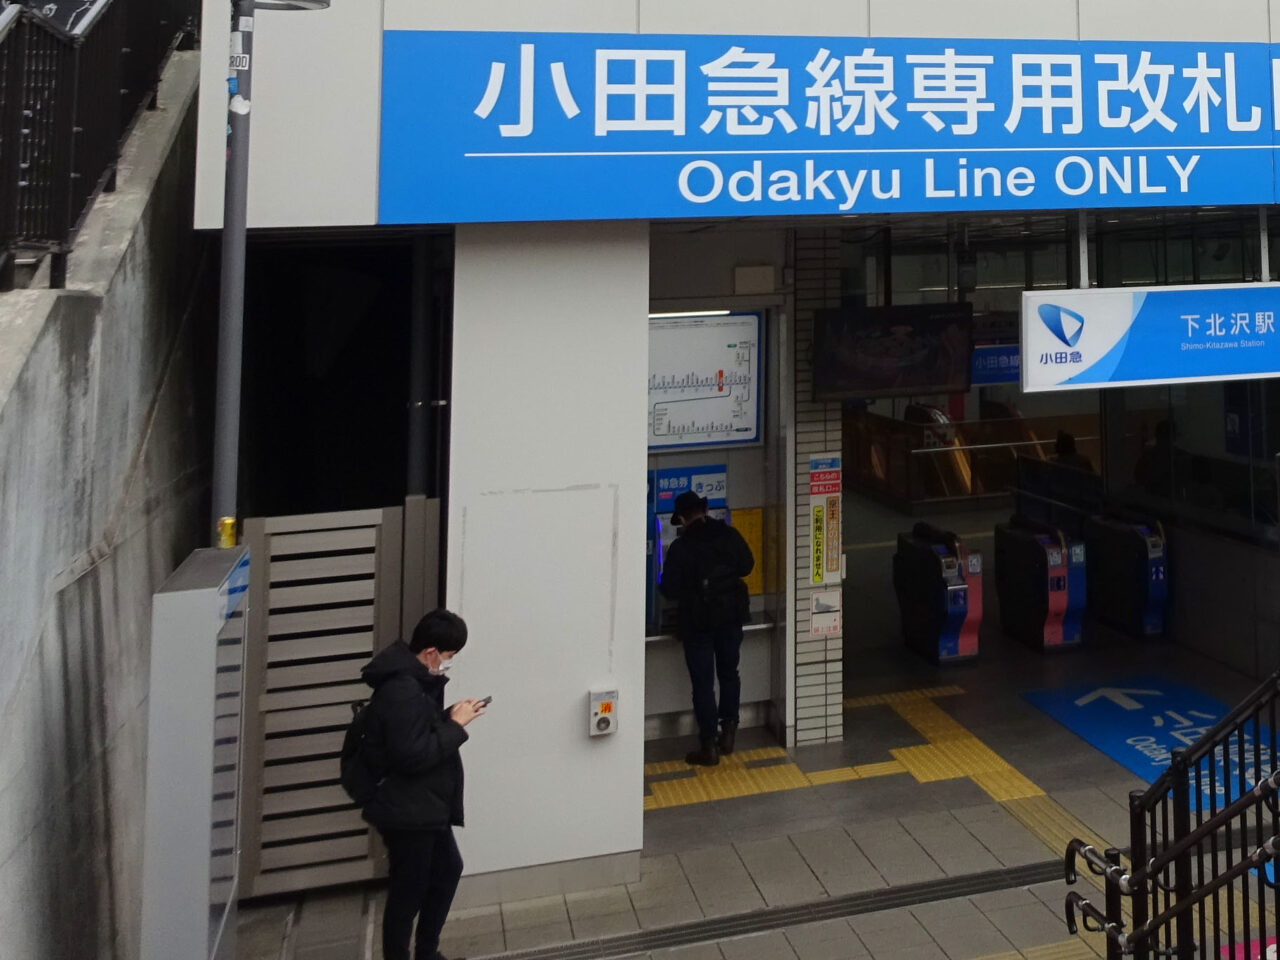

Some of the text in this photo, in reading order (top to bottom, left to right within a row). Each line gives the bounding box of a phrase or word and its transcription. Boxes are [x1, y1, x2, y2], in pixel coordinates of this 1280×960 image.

[677, 154, 1201, 211] Odakyu Line ONLY
[1180, 311, 1275, 338] 下北沢駅
[1180, 338, 1265, 351] Shimo-Kitazawa Station
[1039, 351, 1083, 365] 小田急
